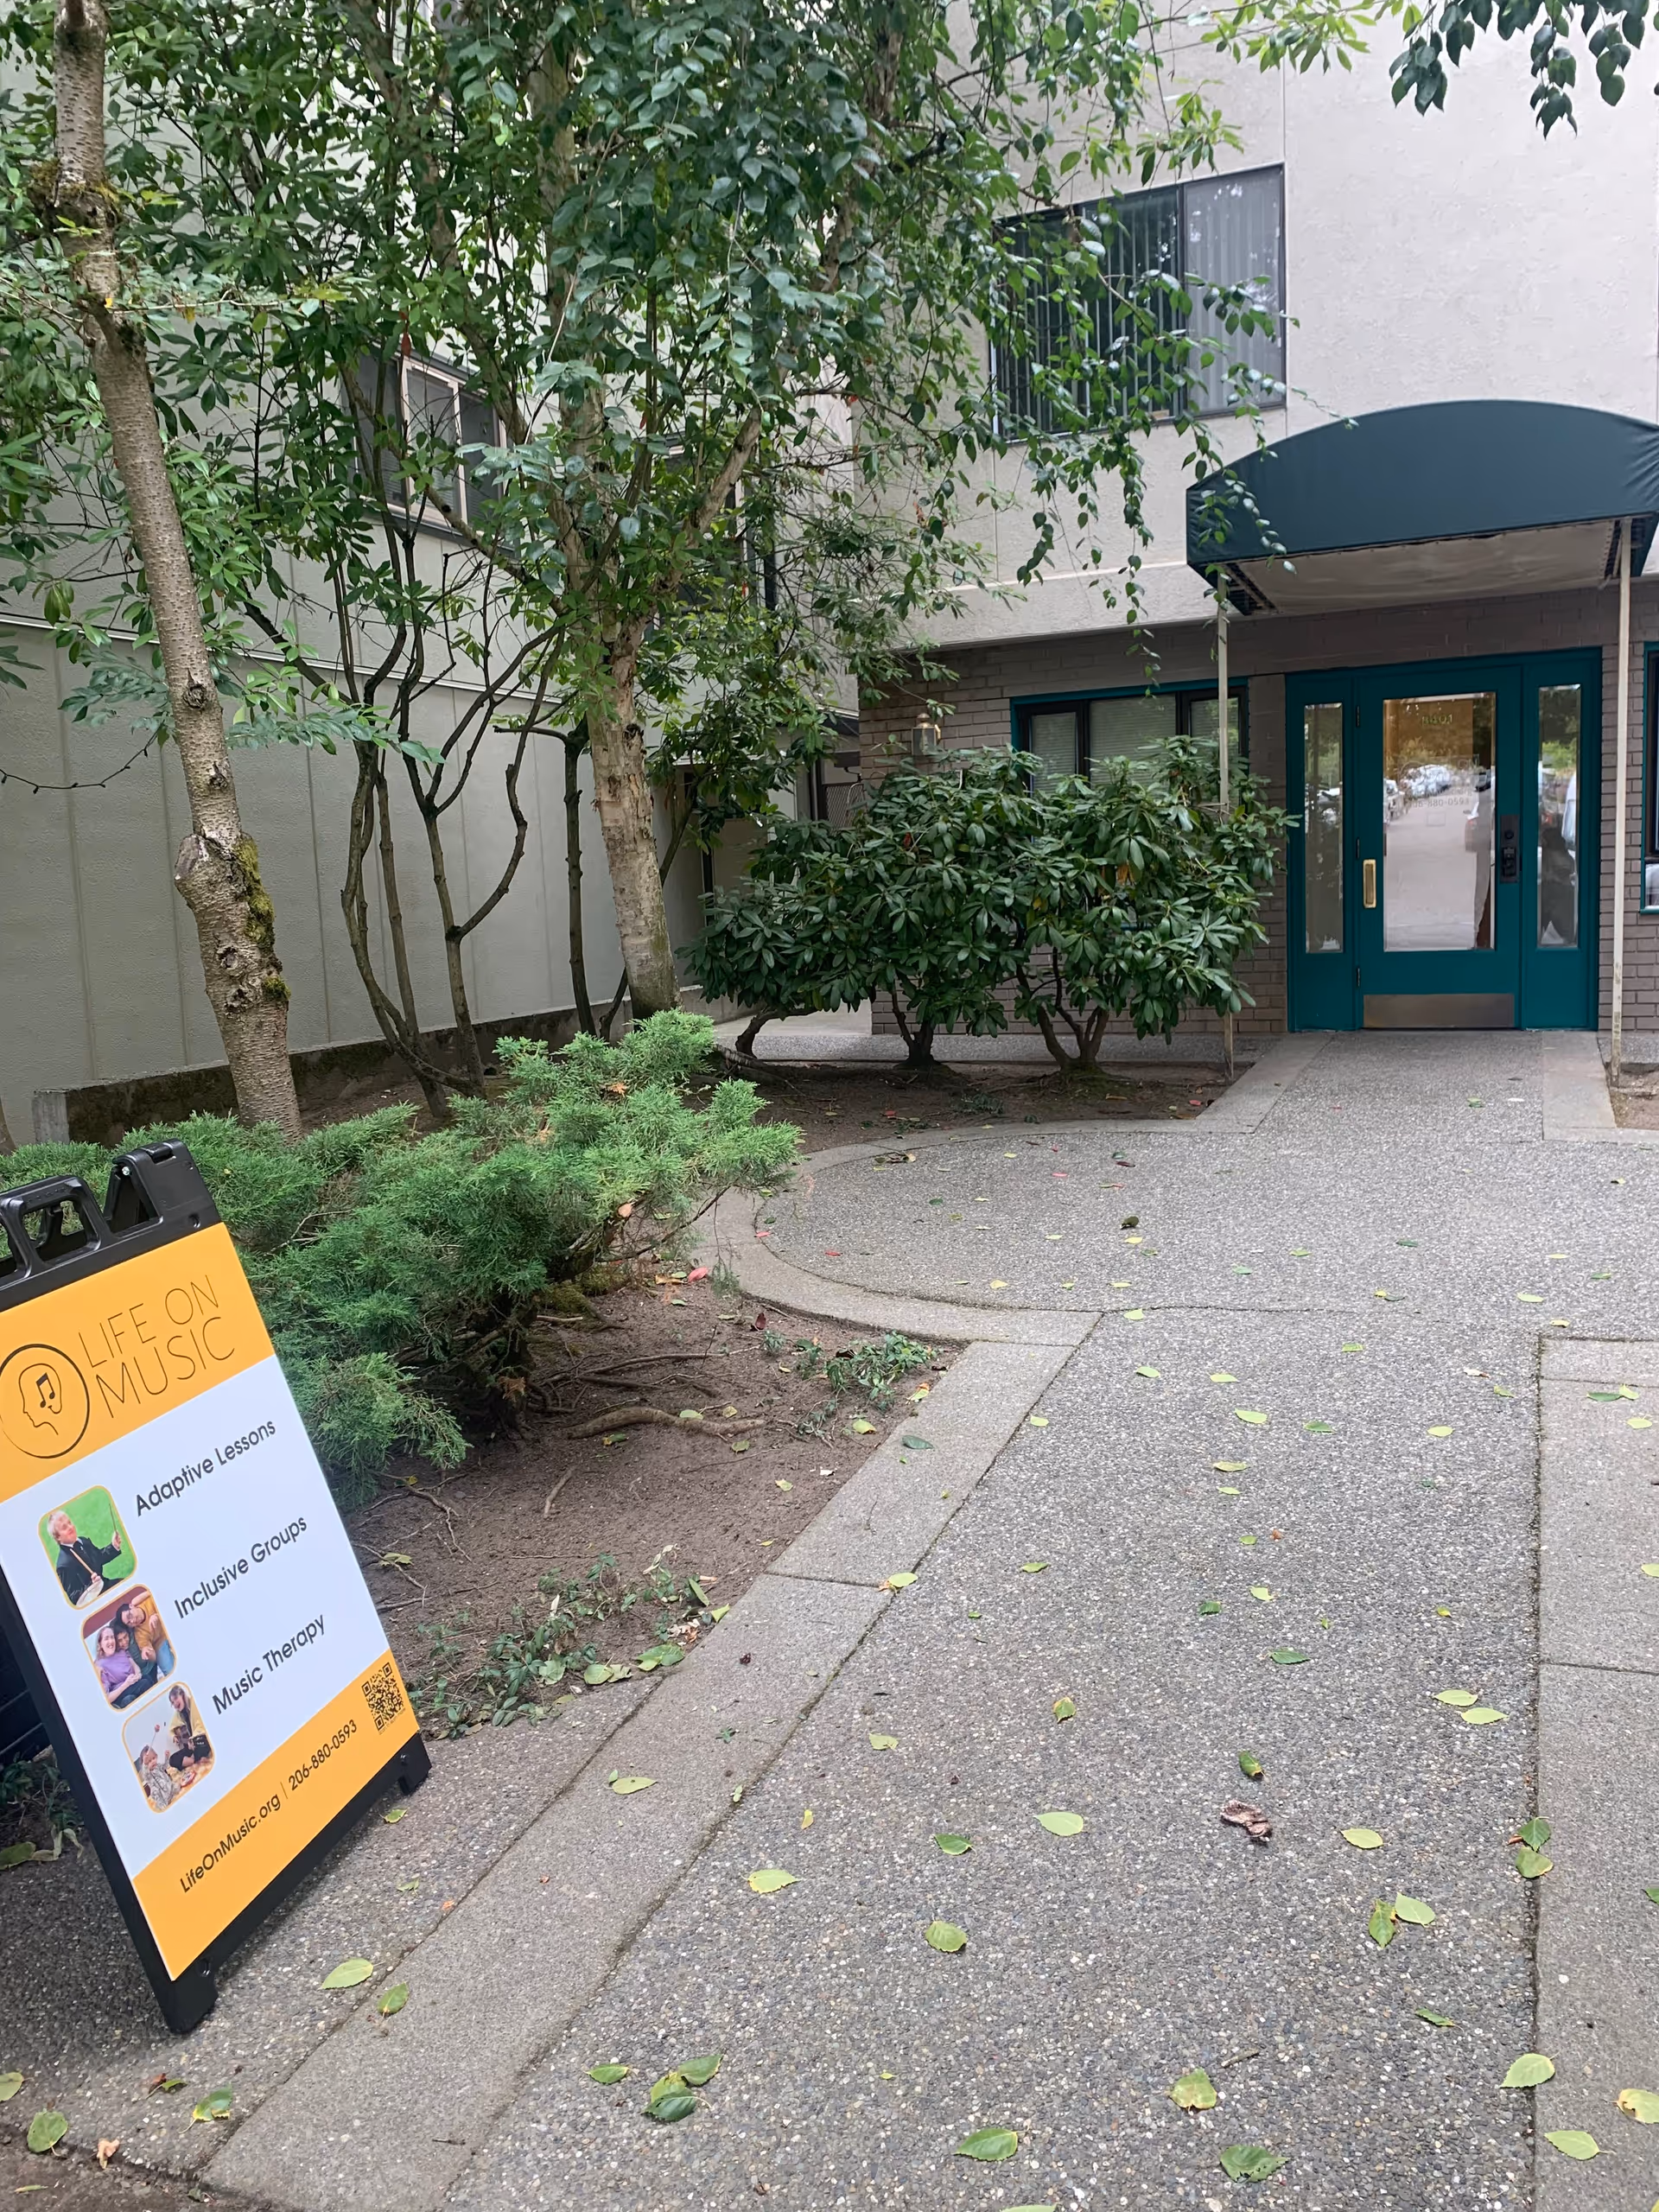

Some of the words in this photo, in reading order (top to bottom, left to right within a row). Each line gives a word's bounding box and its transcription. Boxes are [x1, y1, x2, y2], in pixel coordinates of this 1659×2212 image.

[79, 1303, 156, 1368] LIFE
[165, 1274, 219, 1325] ON
[95, 1316, 235, 1419] MUSIC
[134, 1457, 214, 1517] Adaptive
[214, 1420, 276, 1466] Lessons
[174, 1558, 249, 1619] Inclusive
[251, 1516, 308, 1563] Groups
[212, 1666, 264, 1715] Music
[262, 1614, 325, 1672] Therapy
[179, 1794, 281, 1893] LifeOnMusic.org
[288, 1719, 358, 1791] 206-880-0593
